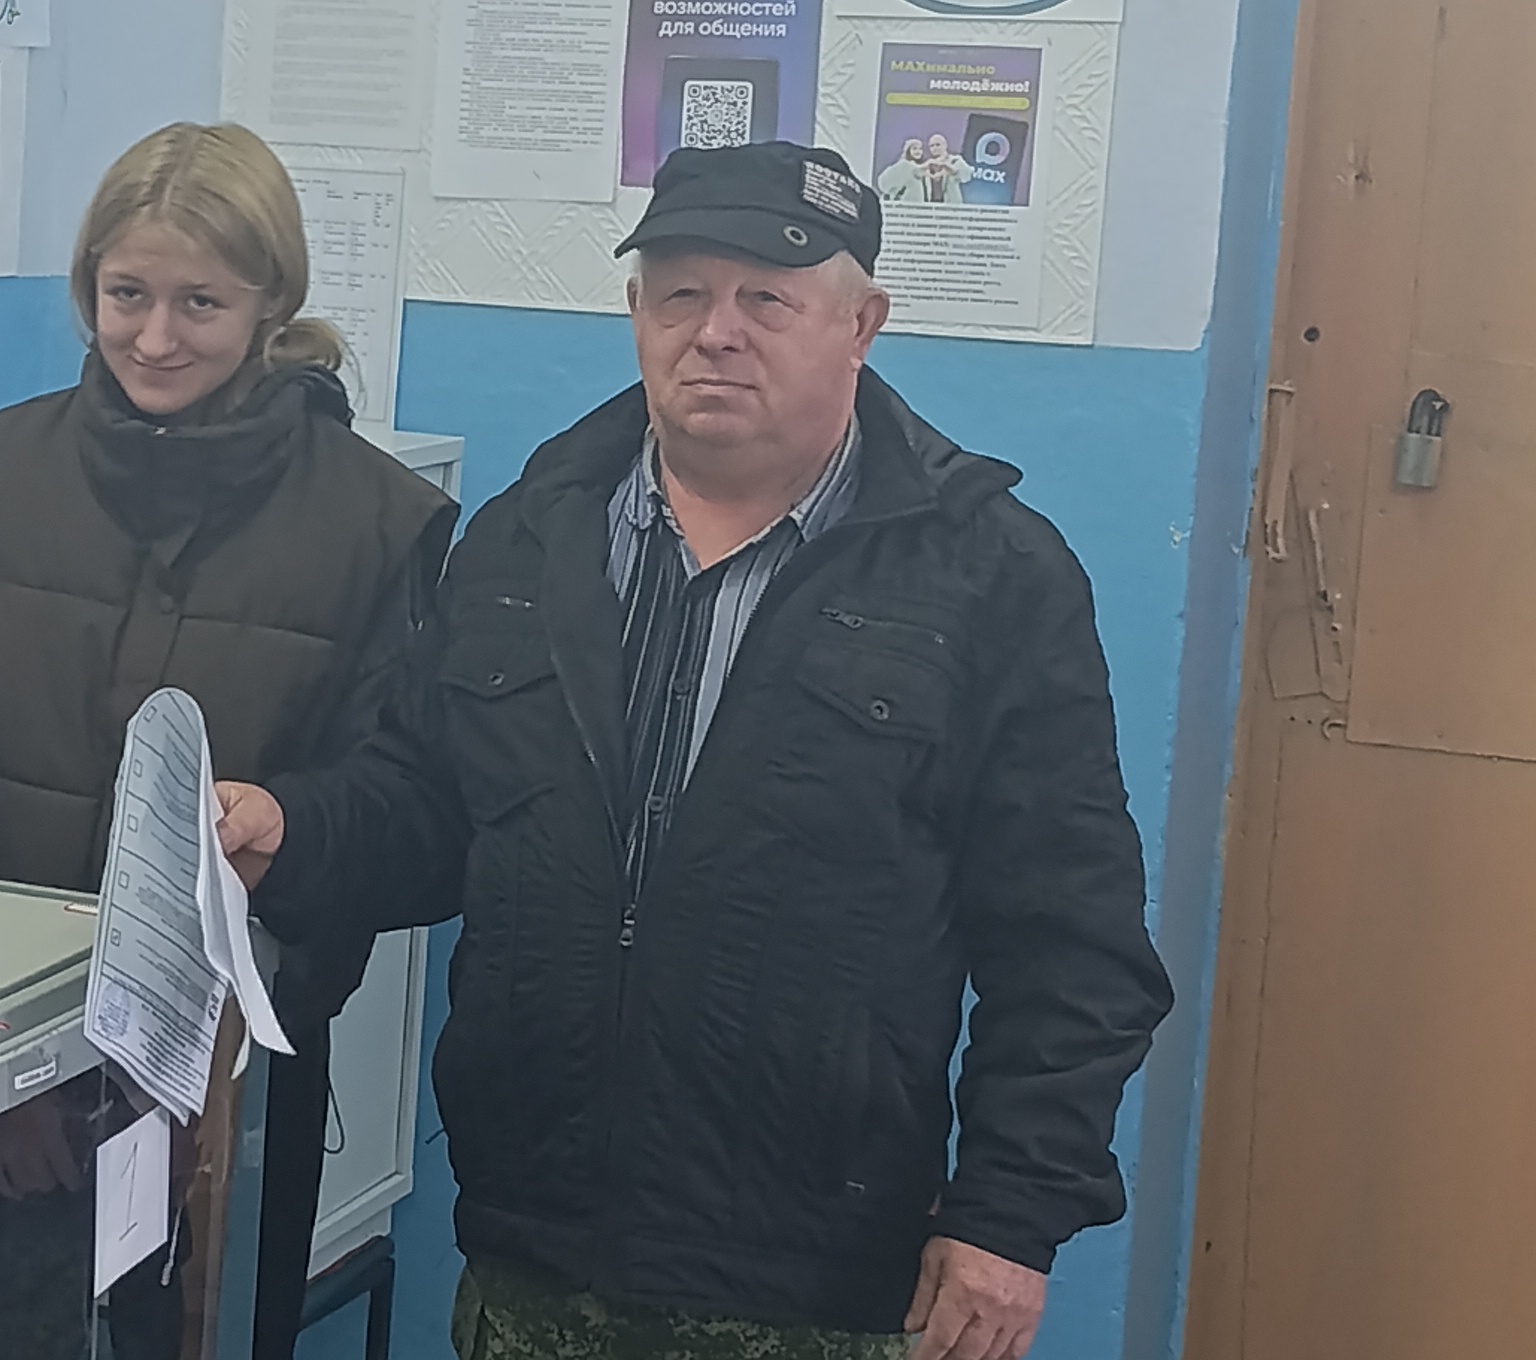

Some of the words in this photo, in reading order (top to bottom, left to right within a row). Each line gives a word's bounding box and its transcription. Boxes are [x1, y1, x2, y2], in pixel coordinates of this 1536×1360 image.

[653, 0, 797, 16] возможностей
[658, 20, 695, 38] для
[698, 19, 787, 38] общения
[929, 78, 1030, 93] молодёжно!
[119, 1140, 139, 1242] 1
